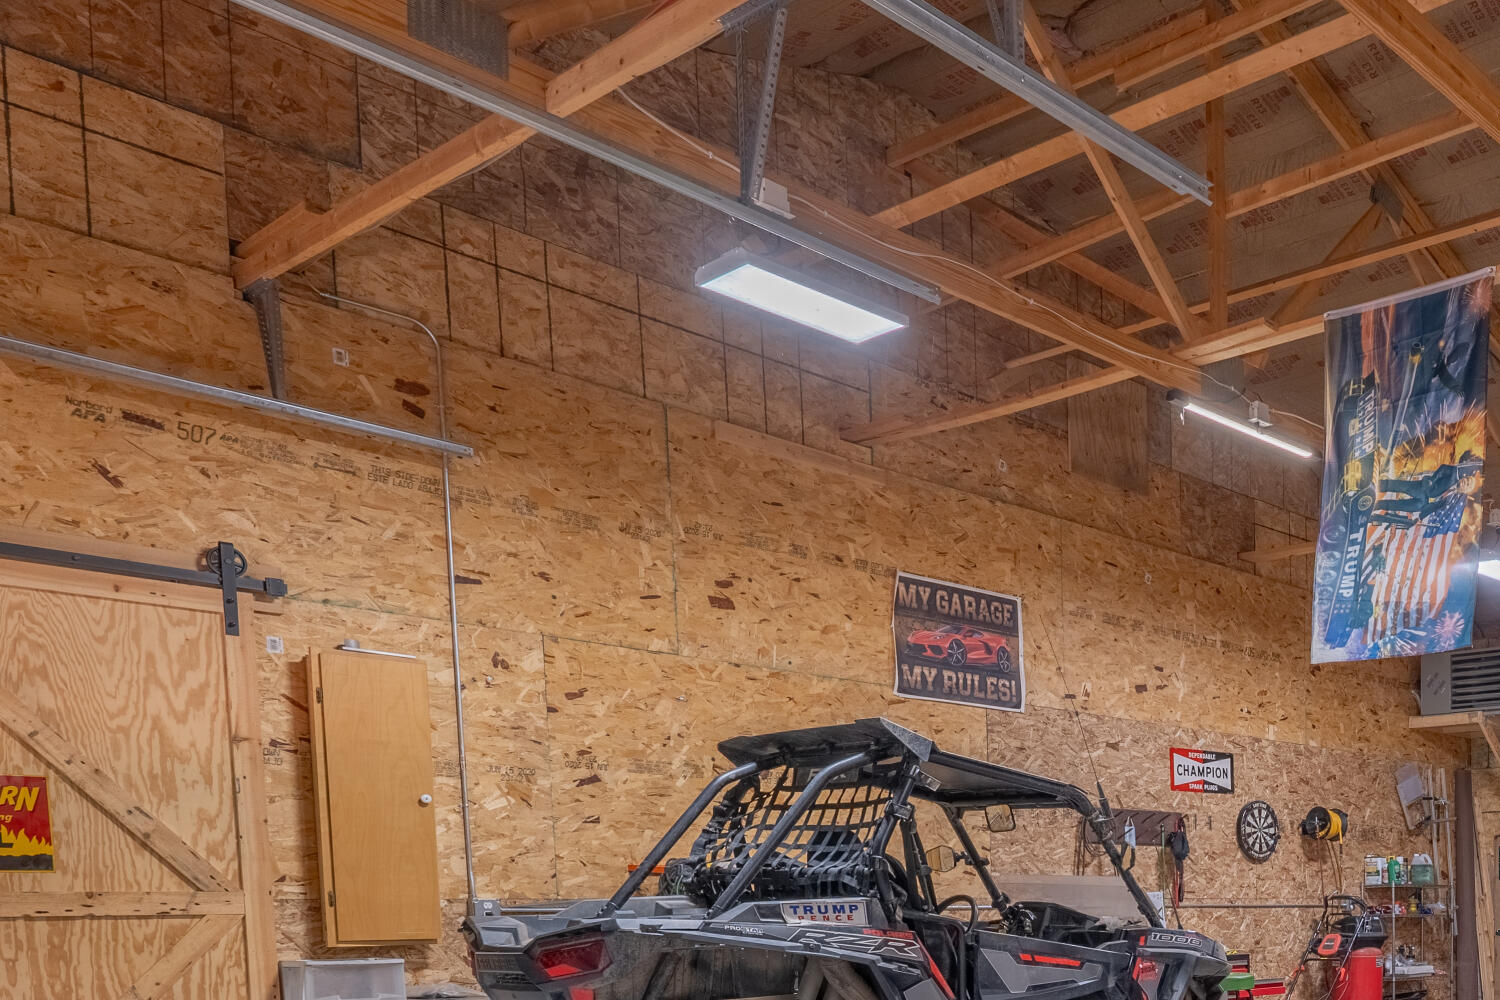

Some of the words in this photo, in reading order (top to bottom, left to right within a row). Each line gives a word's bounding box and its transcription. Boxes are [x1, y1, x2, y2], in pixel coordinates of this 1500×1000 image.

[71, 408, 106, 423] APA
[177, 421, 217, 445] 507
[367, 473, 389, 484] ESTE
[370, 464, 391, 477] THIS
[396, 470, 417, 481] SIDE
[1339, 527, 1364, 598] TRUMP
[899, 582, 931, 611] MY
[935, 589, 1013, 628] GARAGE
[902, 663, 937, 692] MY
[942, 669, 1016, 702] RULES!
[1188, 752, 1216, 760] DEPENDABLE
[1176, 764, 1228, 779] CHAMPION
[789, 904, 859, 915] TRUMP
[1151, 932, 1203, 947] 1000
